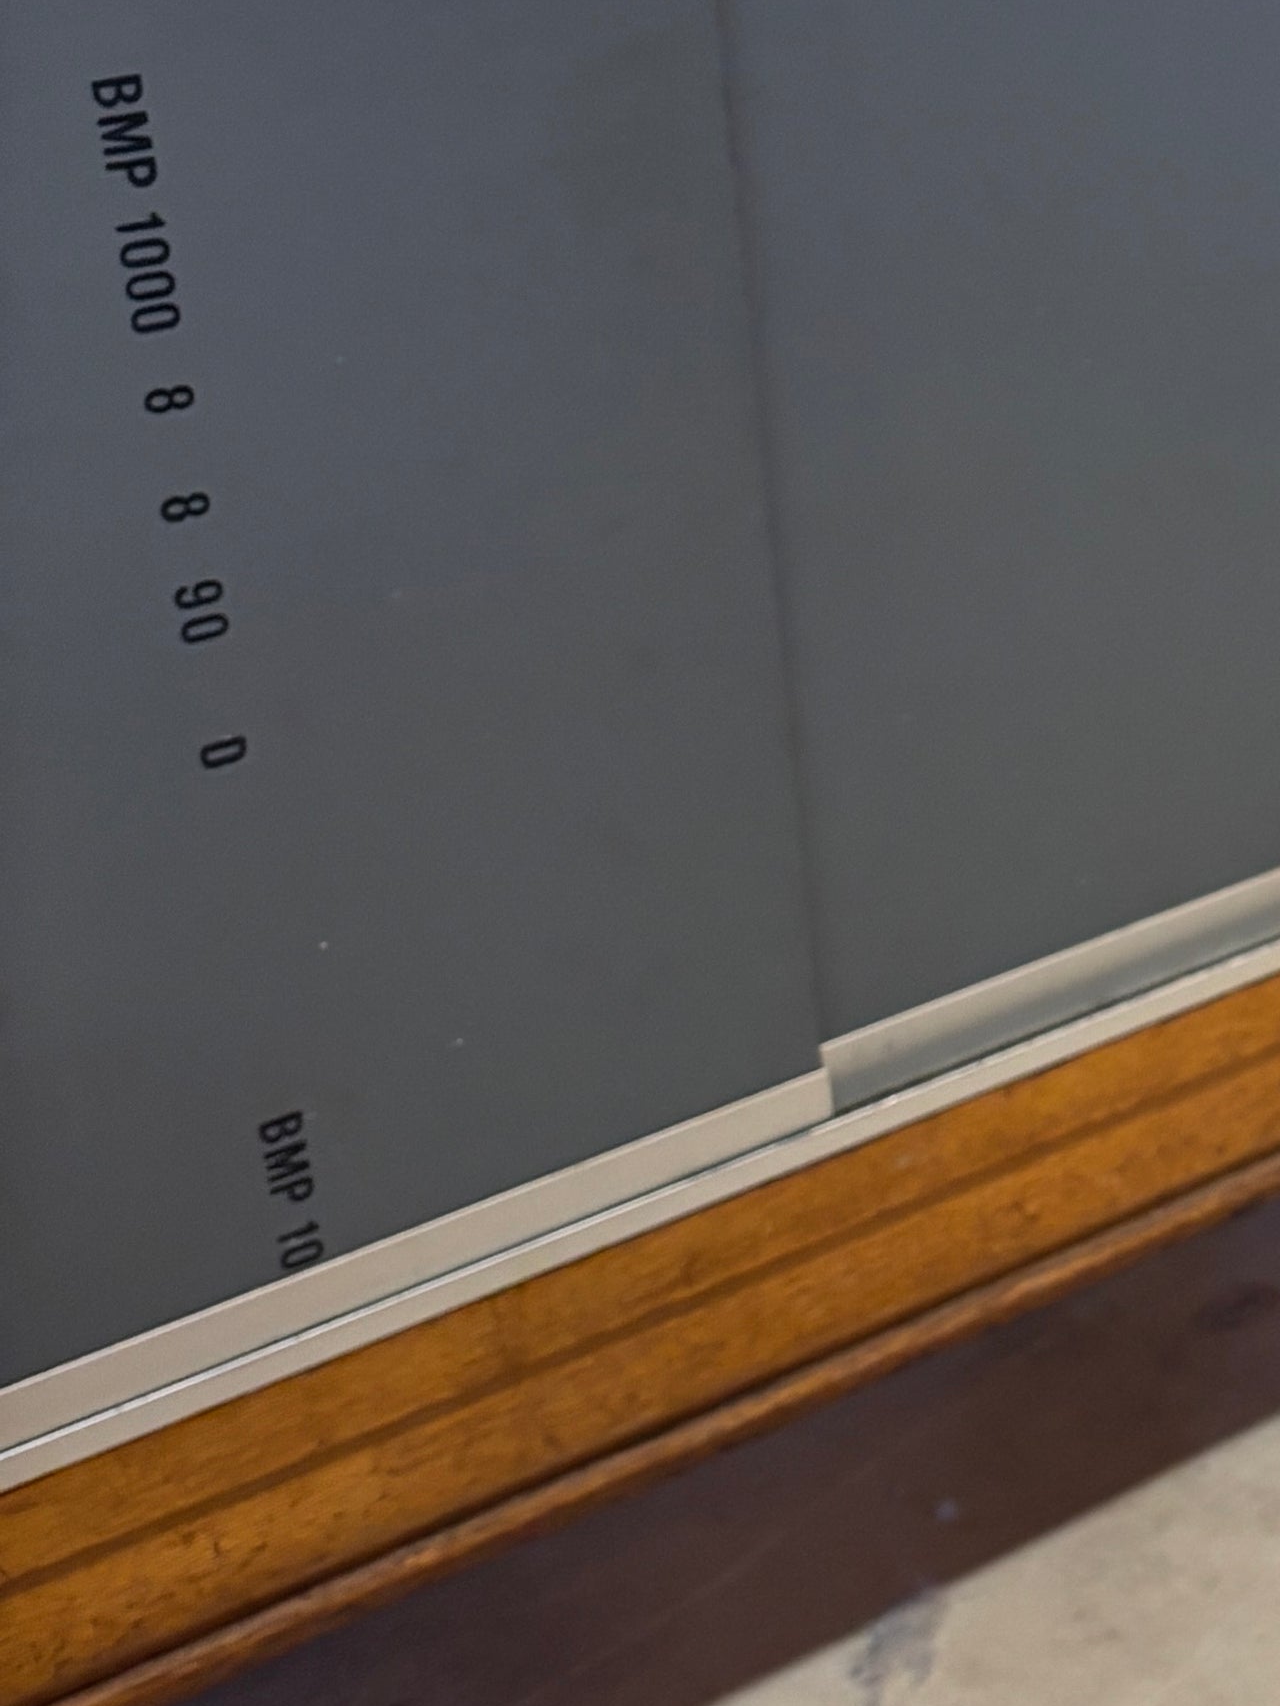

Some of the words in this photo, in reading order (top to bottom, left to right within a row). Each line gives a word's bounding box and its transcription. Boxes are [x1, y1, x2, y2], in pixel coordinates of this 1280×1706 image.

[91, 74, 157, 187] BMP
[116, 213, 180, 333] 1000
[144, 385, 194, 413] 8
[160, 493, 210, 522] 8
[174, 580, 229, 644] 90
[259, 1112, 314, 1202] BMP
